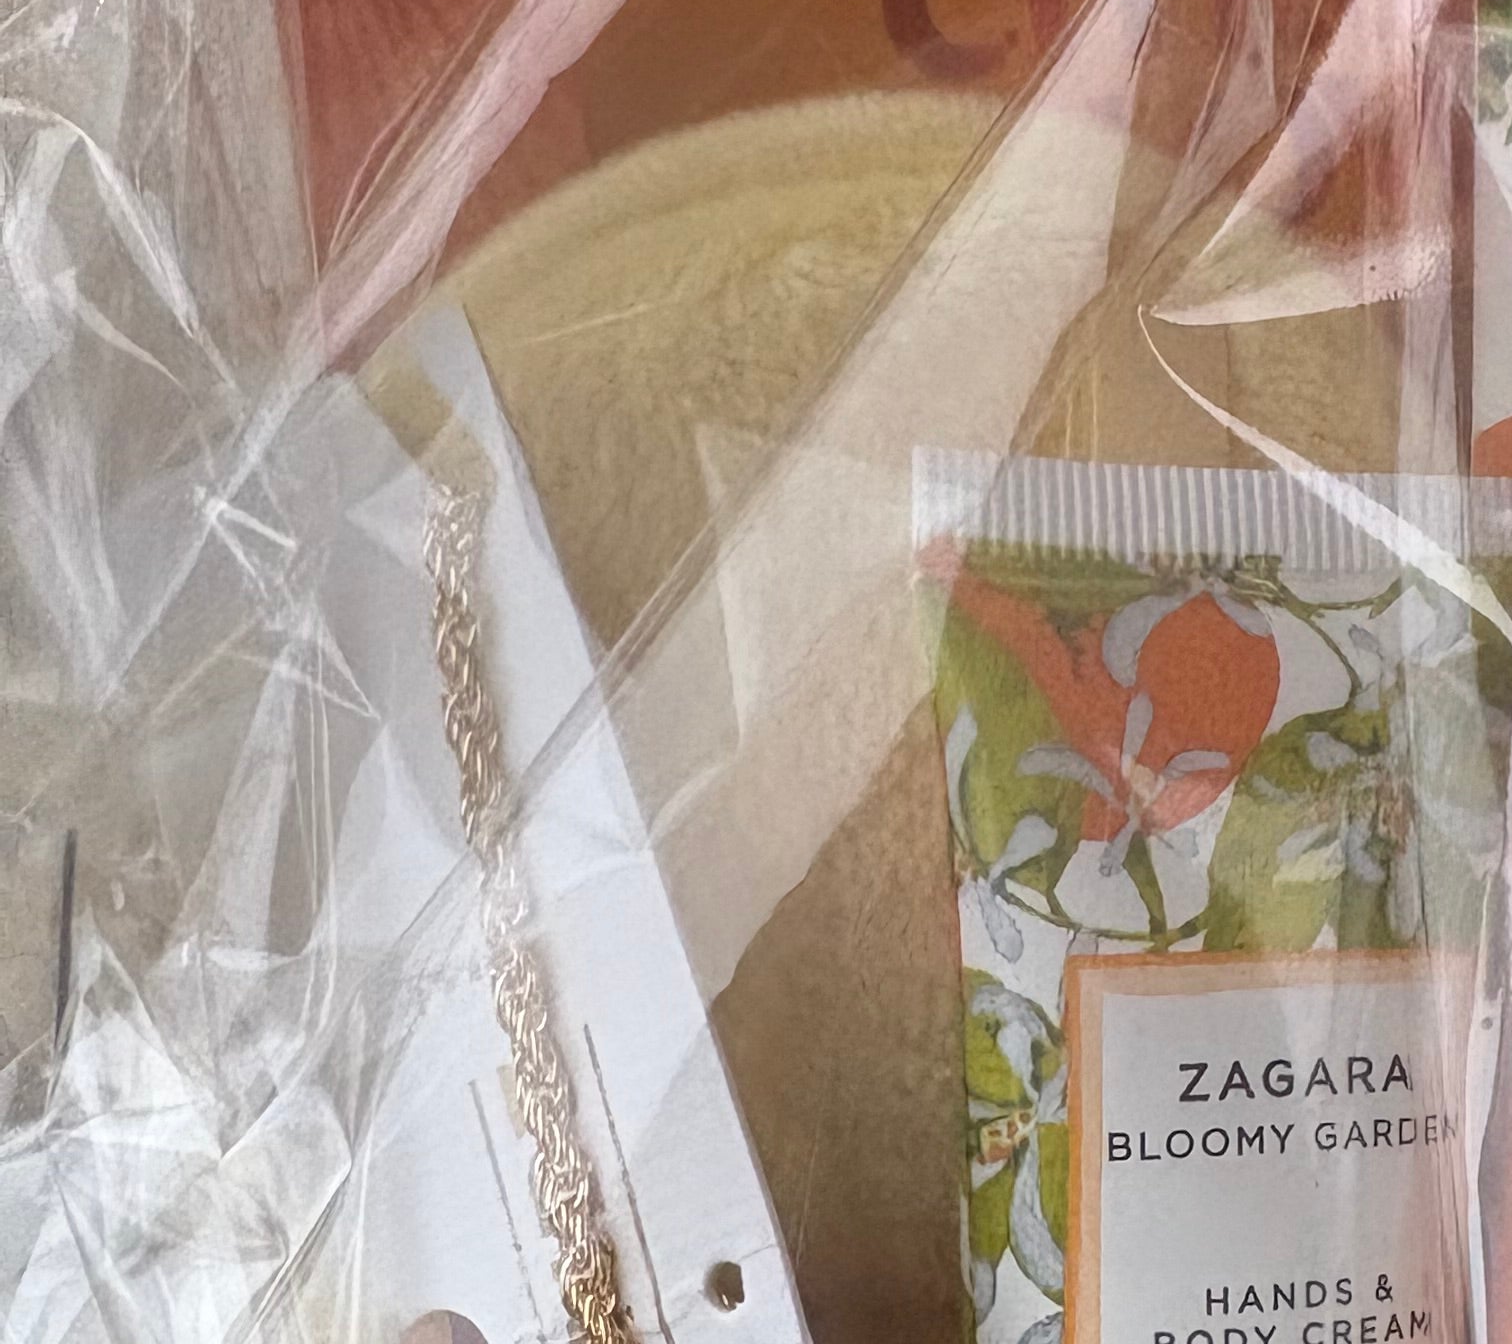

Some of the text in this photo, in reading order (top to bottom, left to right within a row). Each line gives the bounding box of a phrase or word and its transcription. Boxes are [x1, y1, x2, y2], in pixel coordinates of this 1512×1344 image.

[1178, 1053, 1414, 1103] ZAGARA
[1107, 1112, 1458, 1162] BLOOMY GARDEN
[1205, 1273, 1394, 1316] HANDS &
